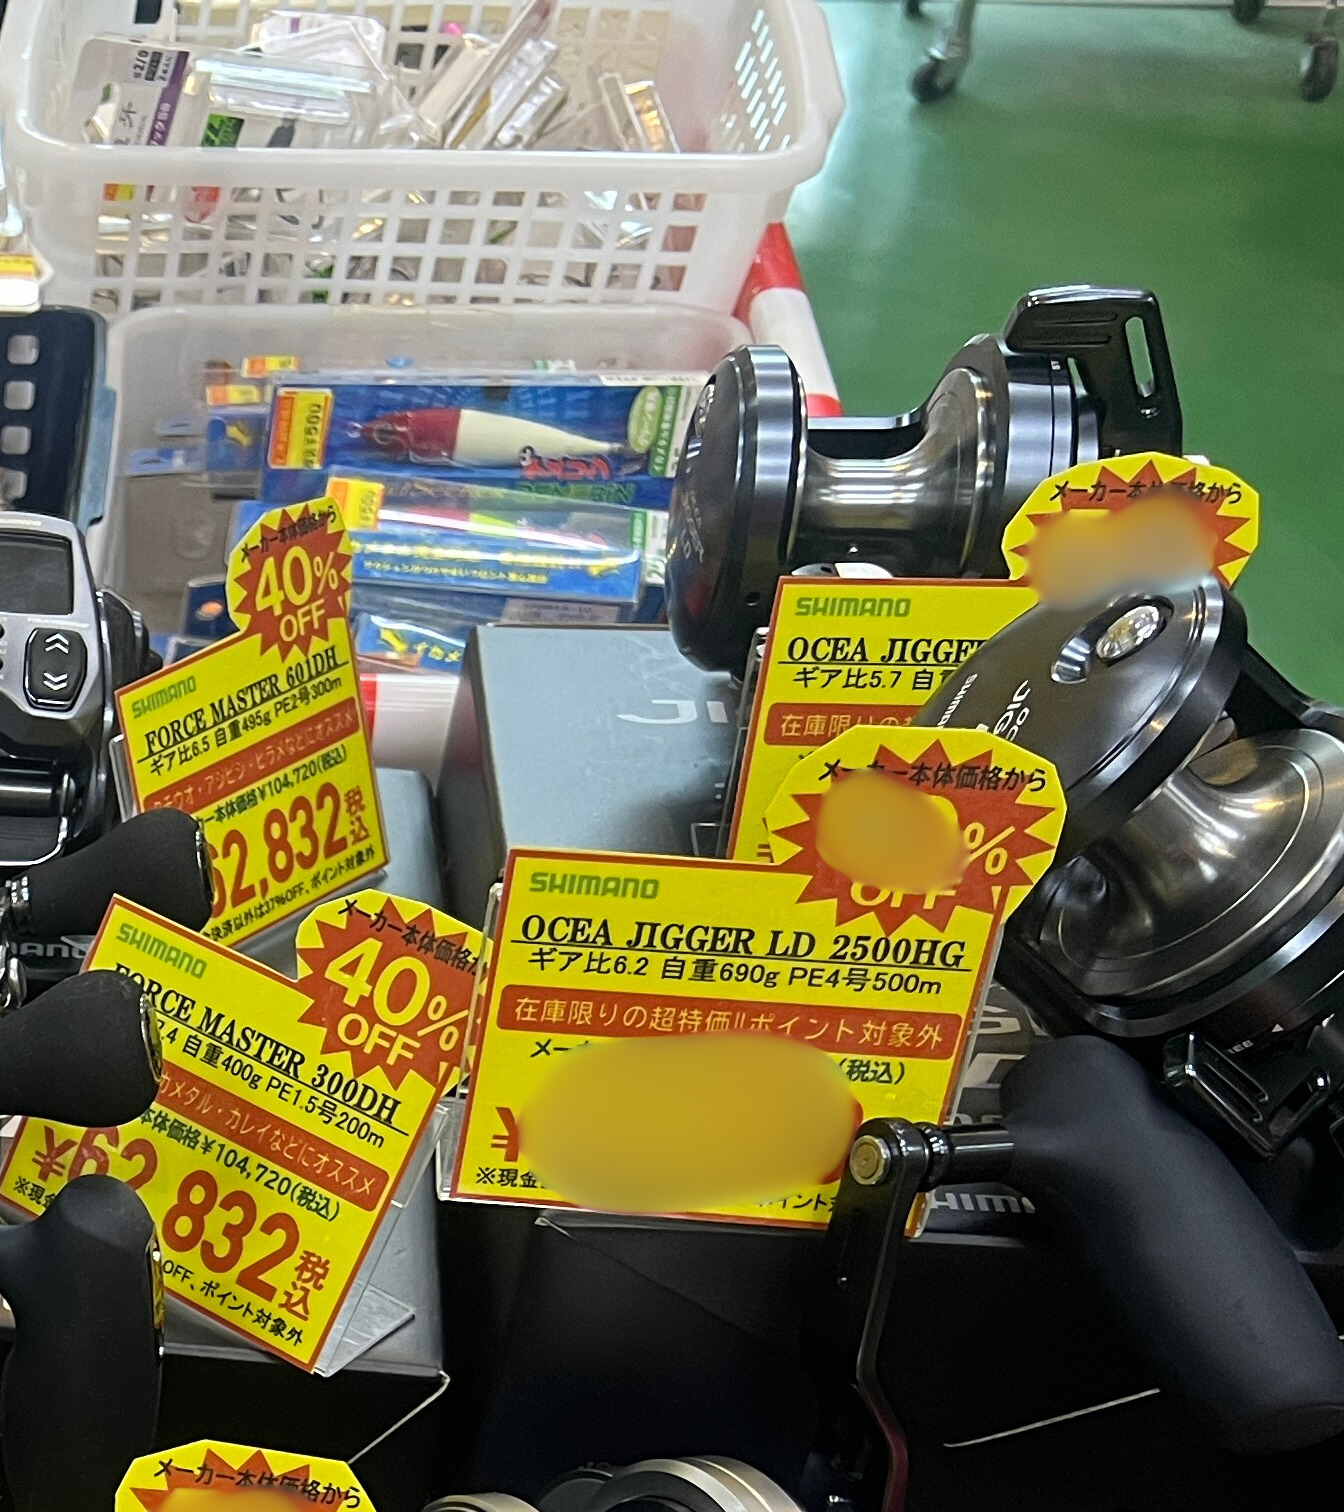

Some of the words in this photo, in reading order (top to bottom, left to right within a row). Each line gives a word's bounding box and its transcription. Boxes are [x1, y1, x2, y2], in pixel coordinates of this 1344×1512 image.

[256, 546, 339, 616] 40%
[795, 597, 911, 617] SHIMANO
[279, 598, 326, 642] OFF
[786, 638, 868, 663] OCEA
[145, 711, 208, 758] FORCE
[211, 680, 281, 726] MASTER
[287, 645, 337, 689] 601DH
[793, 666, 902, 691] ギア比5.7
[151, 739, 210, 776] ギア比6.5
[530, 872, 659, 899] SHIMANO
[117, 923, 208, 980] SHIMANO
[521, 914, 611, 945] OCEA
[626, 923, 753, 955] JIGGER
[766, 931, 816, 958] LD
[832, 936, 965, 969] 2500HG
[325, 939, 470, 1053] 40%
[529, 951, 648, 977] ギア比6.2
[661, 958, 780, 988] 自重690g
[789, 967, 942, 996] PE4号500m
[200, 1006, 307, 1075] MASTER
[310, 1063, 403, 1126] 300DH
[338, 1013, 421, 1066] OFF
[182, 1036, 262, 1089] 自重400g
[266, 1075, 385, 1148] PE1.5号200m
[277, 1250, 329, 1321] 税込
